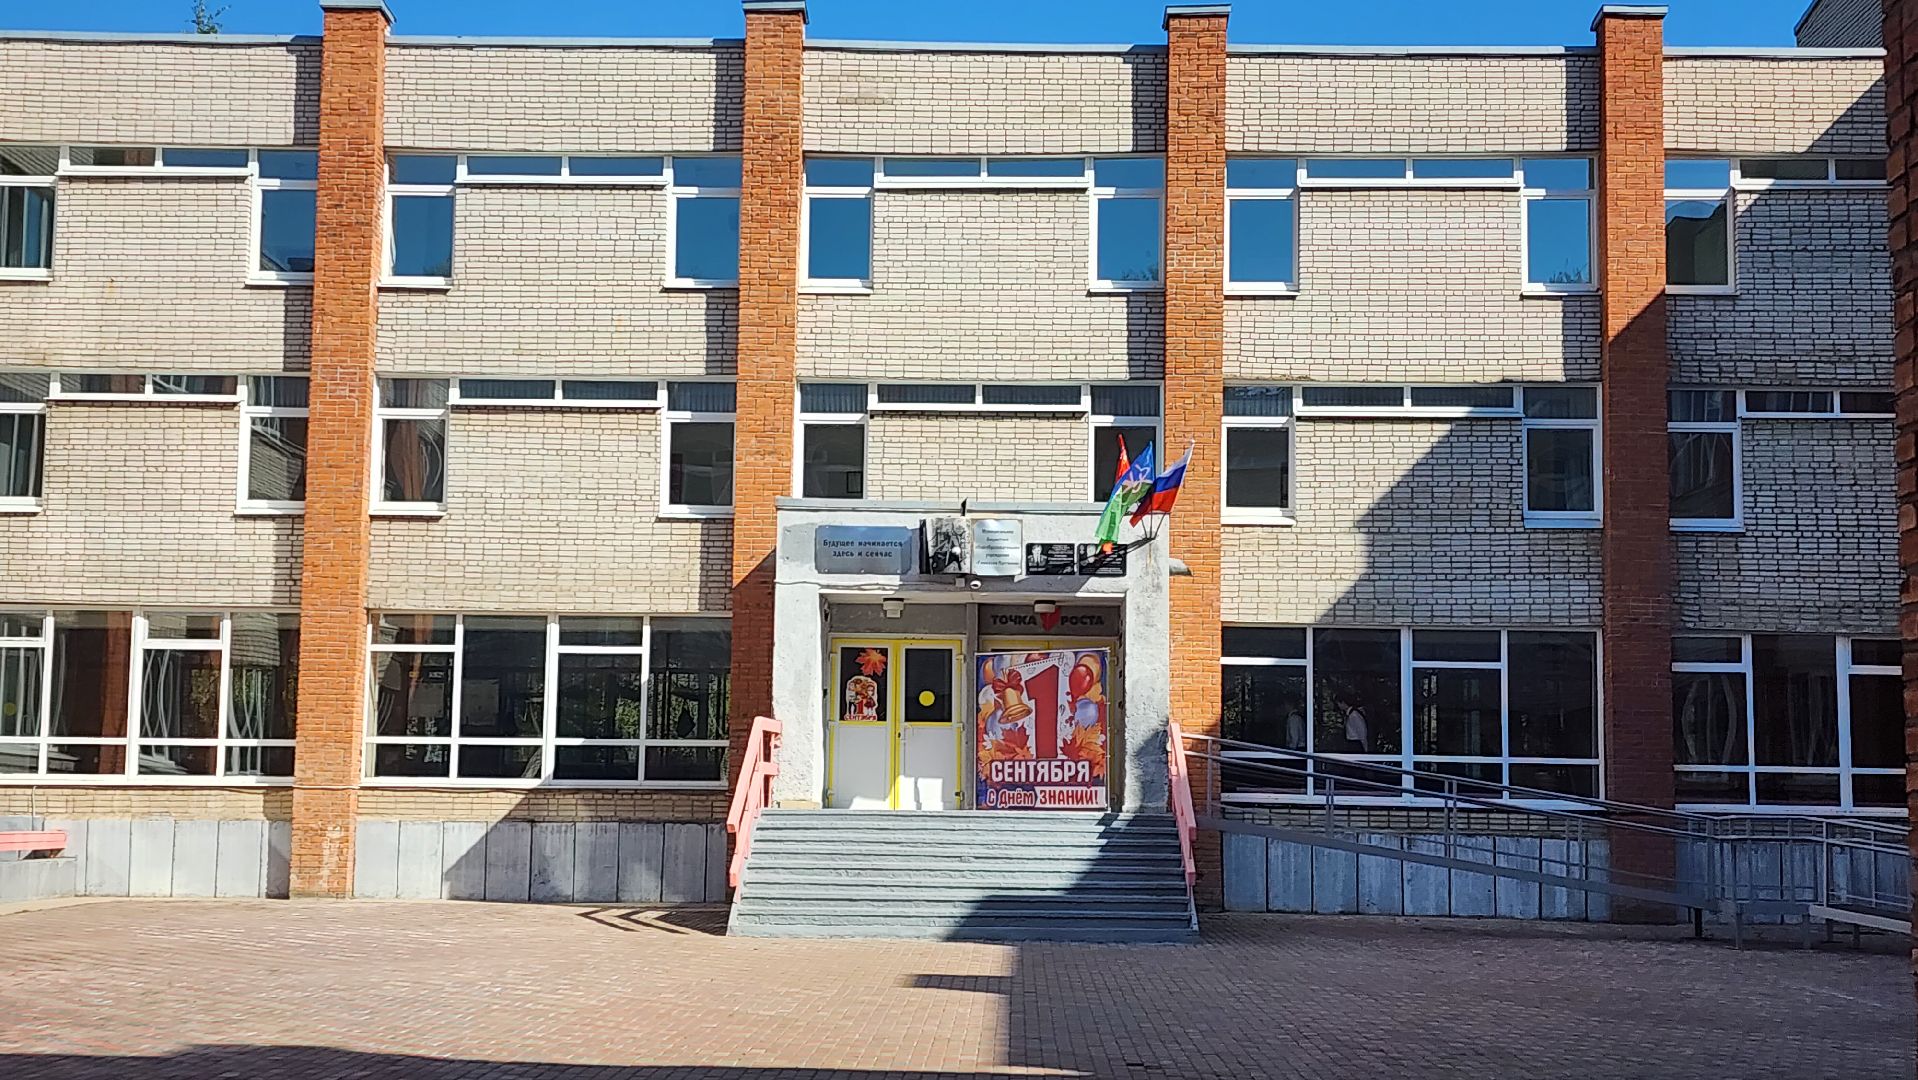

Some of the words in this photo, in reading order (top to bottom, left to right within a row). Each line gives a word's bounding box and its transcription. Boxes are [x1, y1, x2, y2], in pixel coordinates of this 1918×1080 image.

[823, 539, 855, 548] Будущее
[991, 614, 1038, 626] ТОЧКА
[1060, 615, 1104, 626] РОСТА
[1025, 664, 1059, 758] 1
[991, 761, 1090, 783] СЕНТЯБРЯ
[1039, 785, 1099, 805] ЗНАНИЙ!
